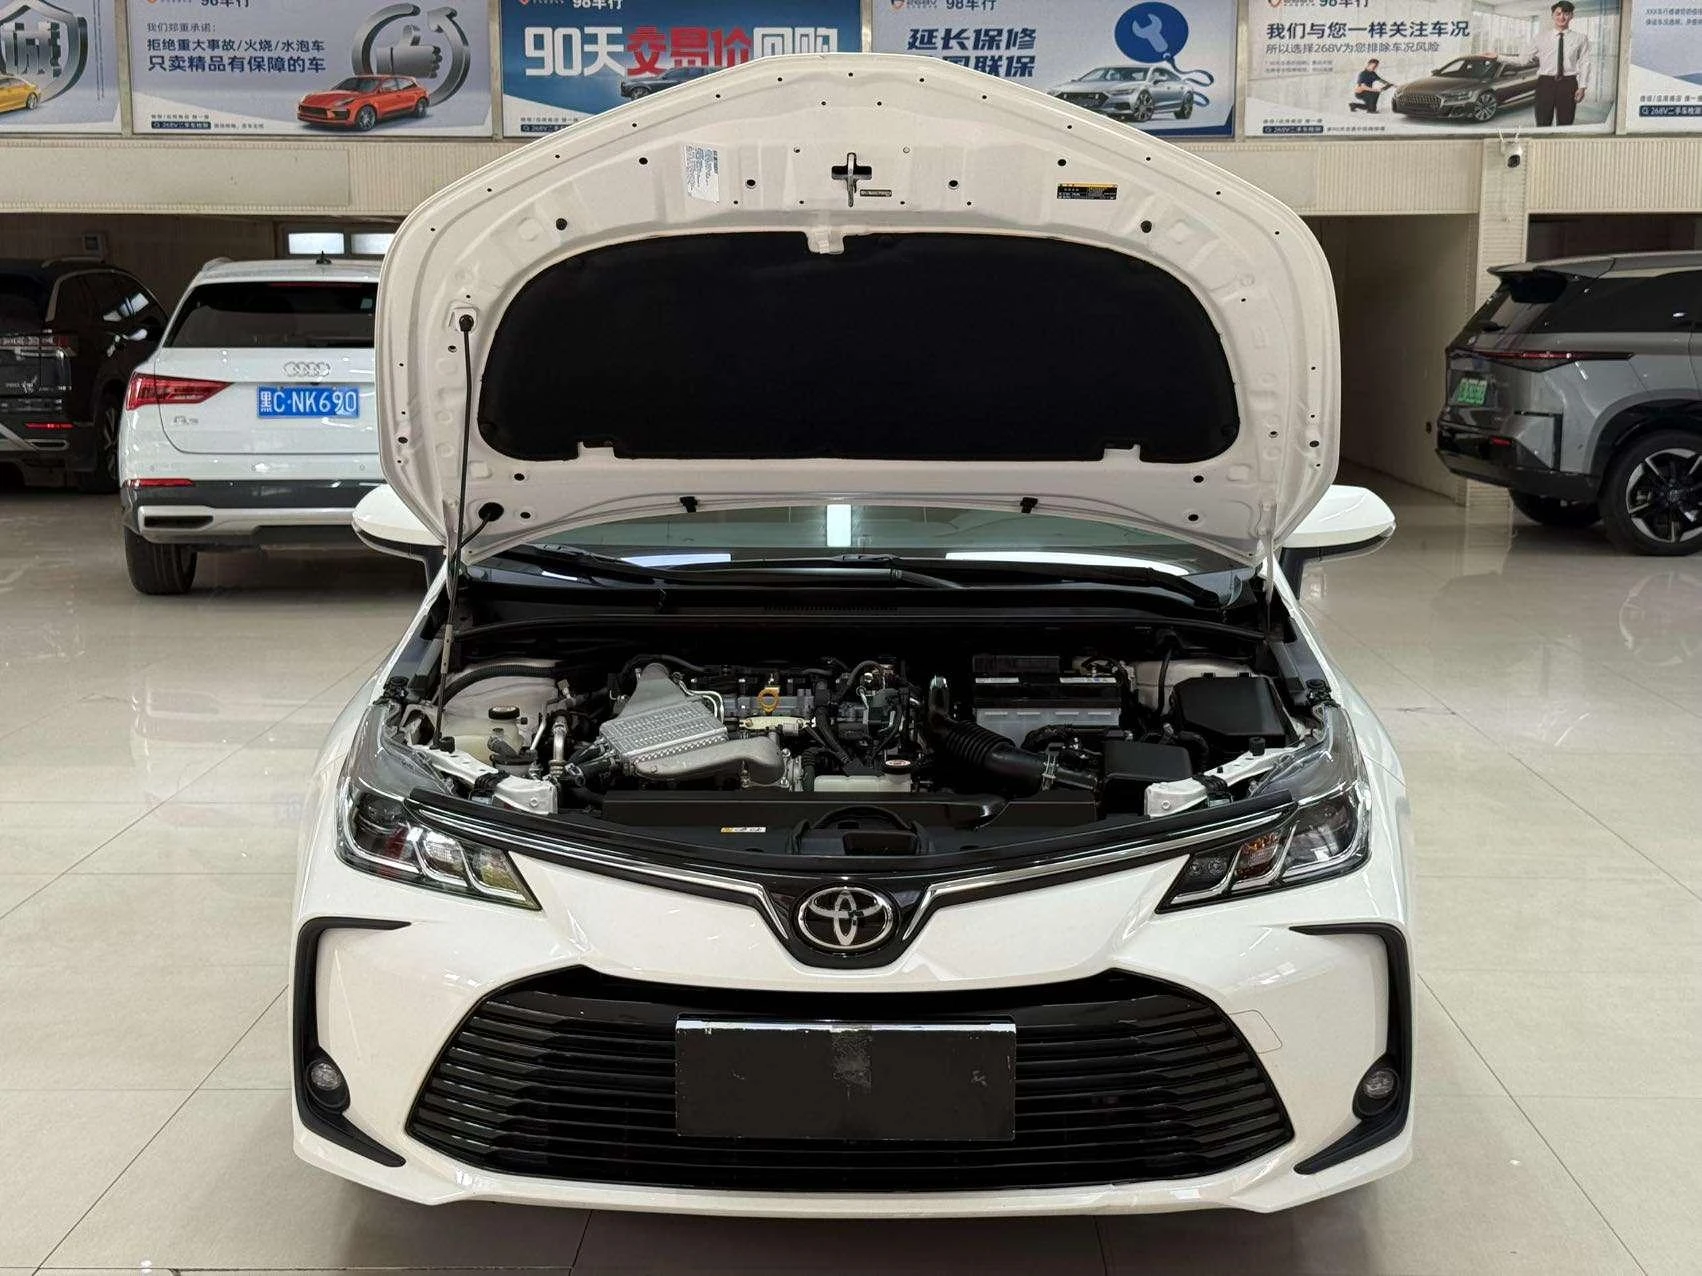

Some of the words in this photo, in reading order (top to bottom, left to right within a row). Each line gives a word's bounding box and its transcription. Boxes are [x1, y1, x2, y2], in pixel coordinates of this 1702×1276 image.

[907, 27, 1036, 50] 延长保修
[1266, 21, 1471, 39] 我们与您一样关注车况
[147, 38, 326, 53] 拒绝重大事故/火烧/水泡车
[1265, 41, 1441, 54] 所以选择268V为您排除车况风险
[148, 55, 326, 73] 只卖精品有保障的车
